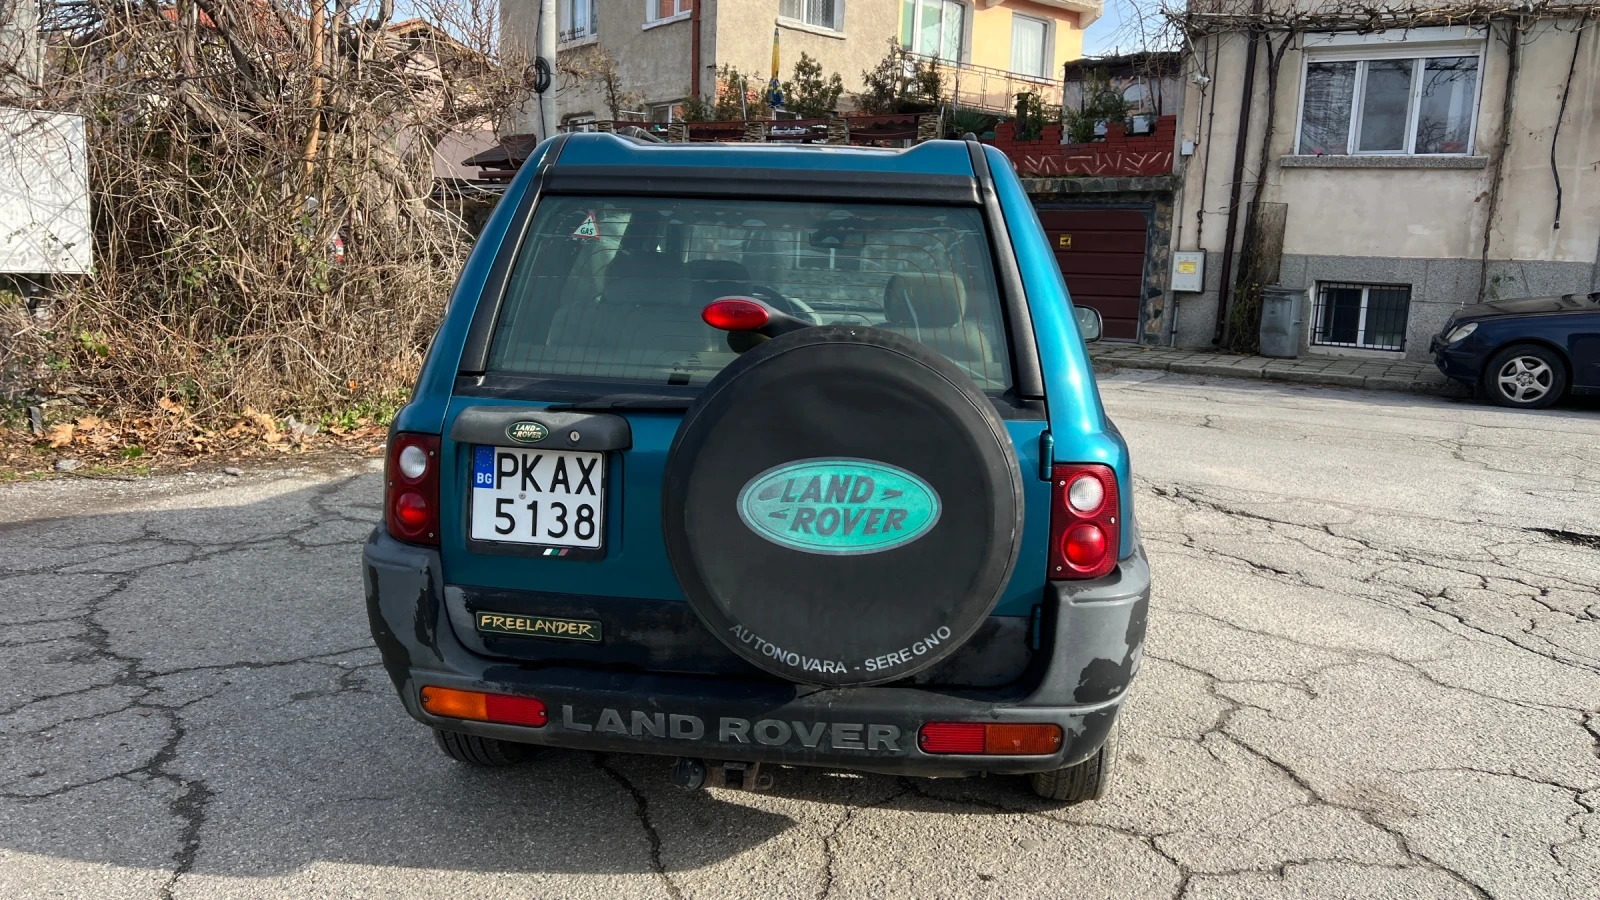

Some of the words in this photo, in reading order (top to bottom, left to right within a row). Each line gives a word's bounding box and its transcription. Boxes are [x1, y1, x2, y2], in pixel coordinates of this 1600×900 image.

[580, 227, 594, 235] GAS
[516, 431, 542, 439] ROVER
[476, 472, 492, 485] BG
[780, 474, 875, 504] LAND
[495, 497, 595, 540] 5138
[789, 507, 908, 537] ROVER
[481, 615, 595, 638] FREELANDER
[729, 624, 847, 674] AUTONOVARA
[864, 625, 951, 672] SEREGNO
[562, 704, 704, 740] LAND
[719, 716, 901, 751] ROVER
